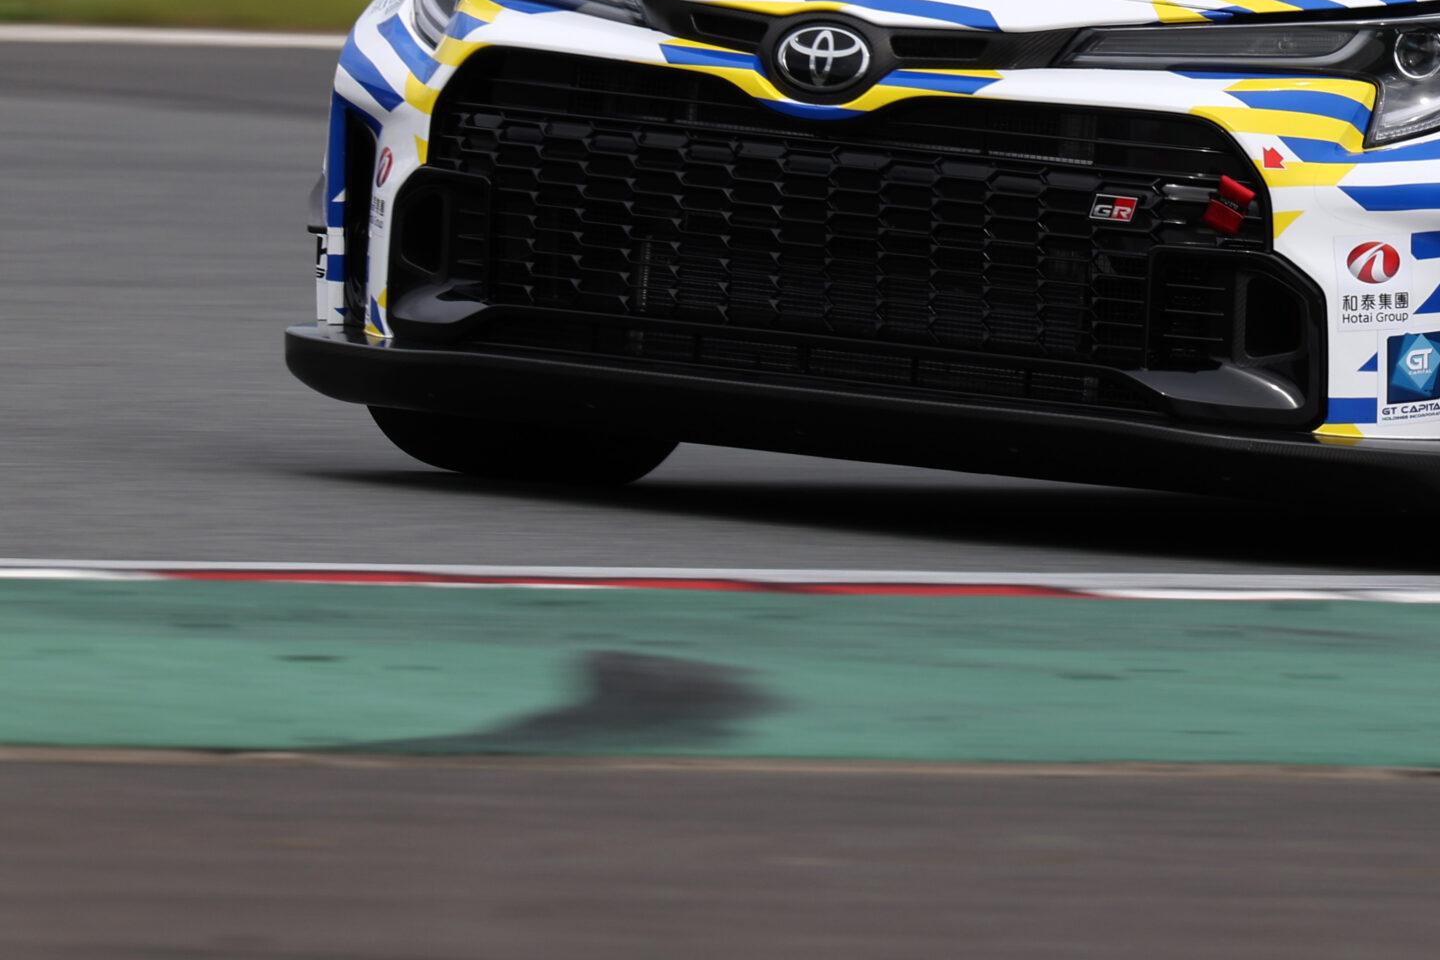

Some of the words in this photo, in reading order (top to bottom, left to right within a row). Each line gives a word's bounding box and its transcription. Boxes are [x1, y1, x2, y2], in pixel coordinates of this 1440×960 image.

[1092, 203, 1133, 219] GR
[1342, 292, 1409, 311] 和泰集團
[1342, 312, 1373, 323] Hotai
[1376, 311, 1409, 323] Group
[1405, 347, 1434, 371] GT
[1381, 406, 1398, 415] GT
